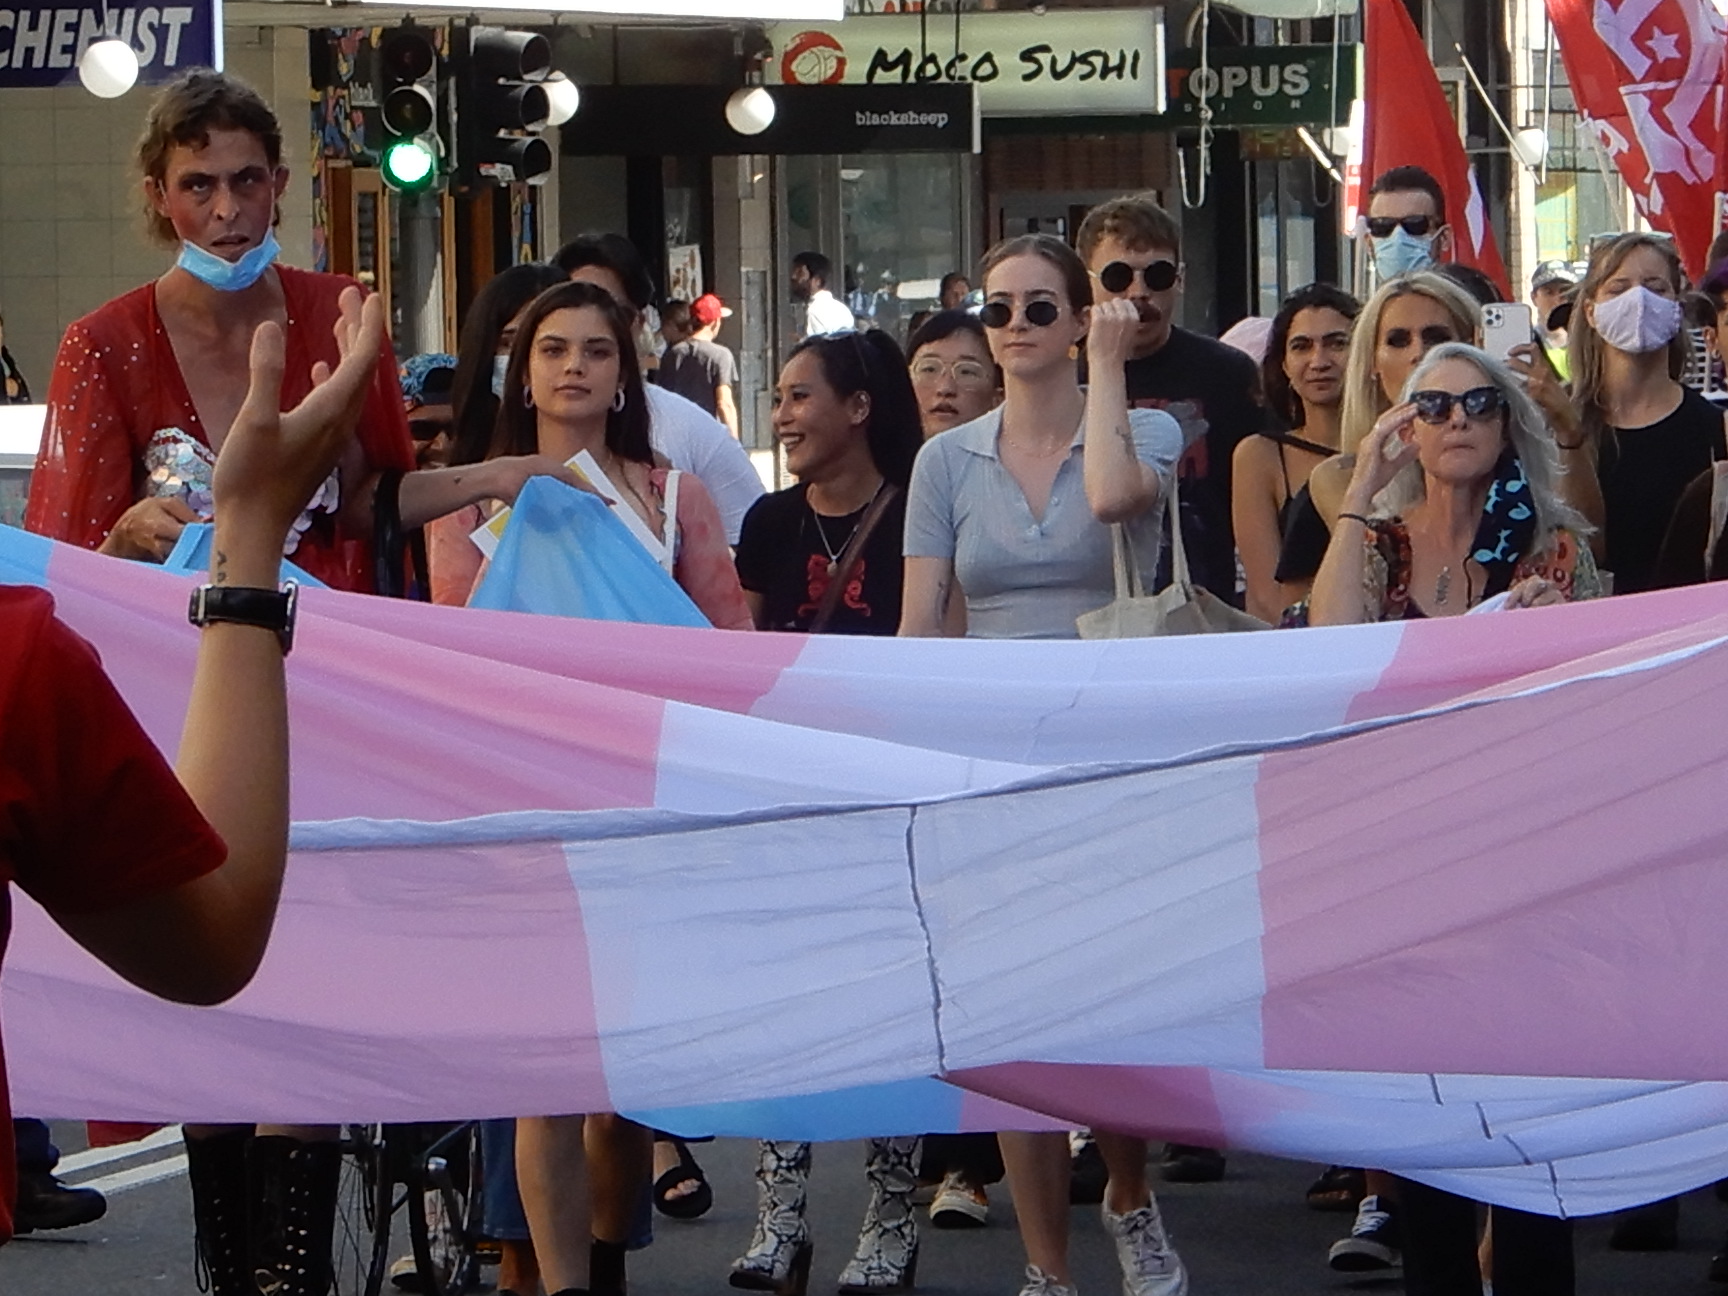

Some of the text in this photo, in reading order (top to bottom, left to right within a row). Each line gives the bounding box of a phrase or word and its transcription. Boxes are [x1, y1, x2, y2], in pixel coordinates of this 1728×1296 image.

[866, 43, 1140, 84] MOCO SUSHI
[1167, 62, 1311, 99] TOPUS
[855, 111, 949, 129] blacksheep
